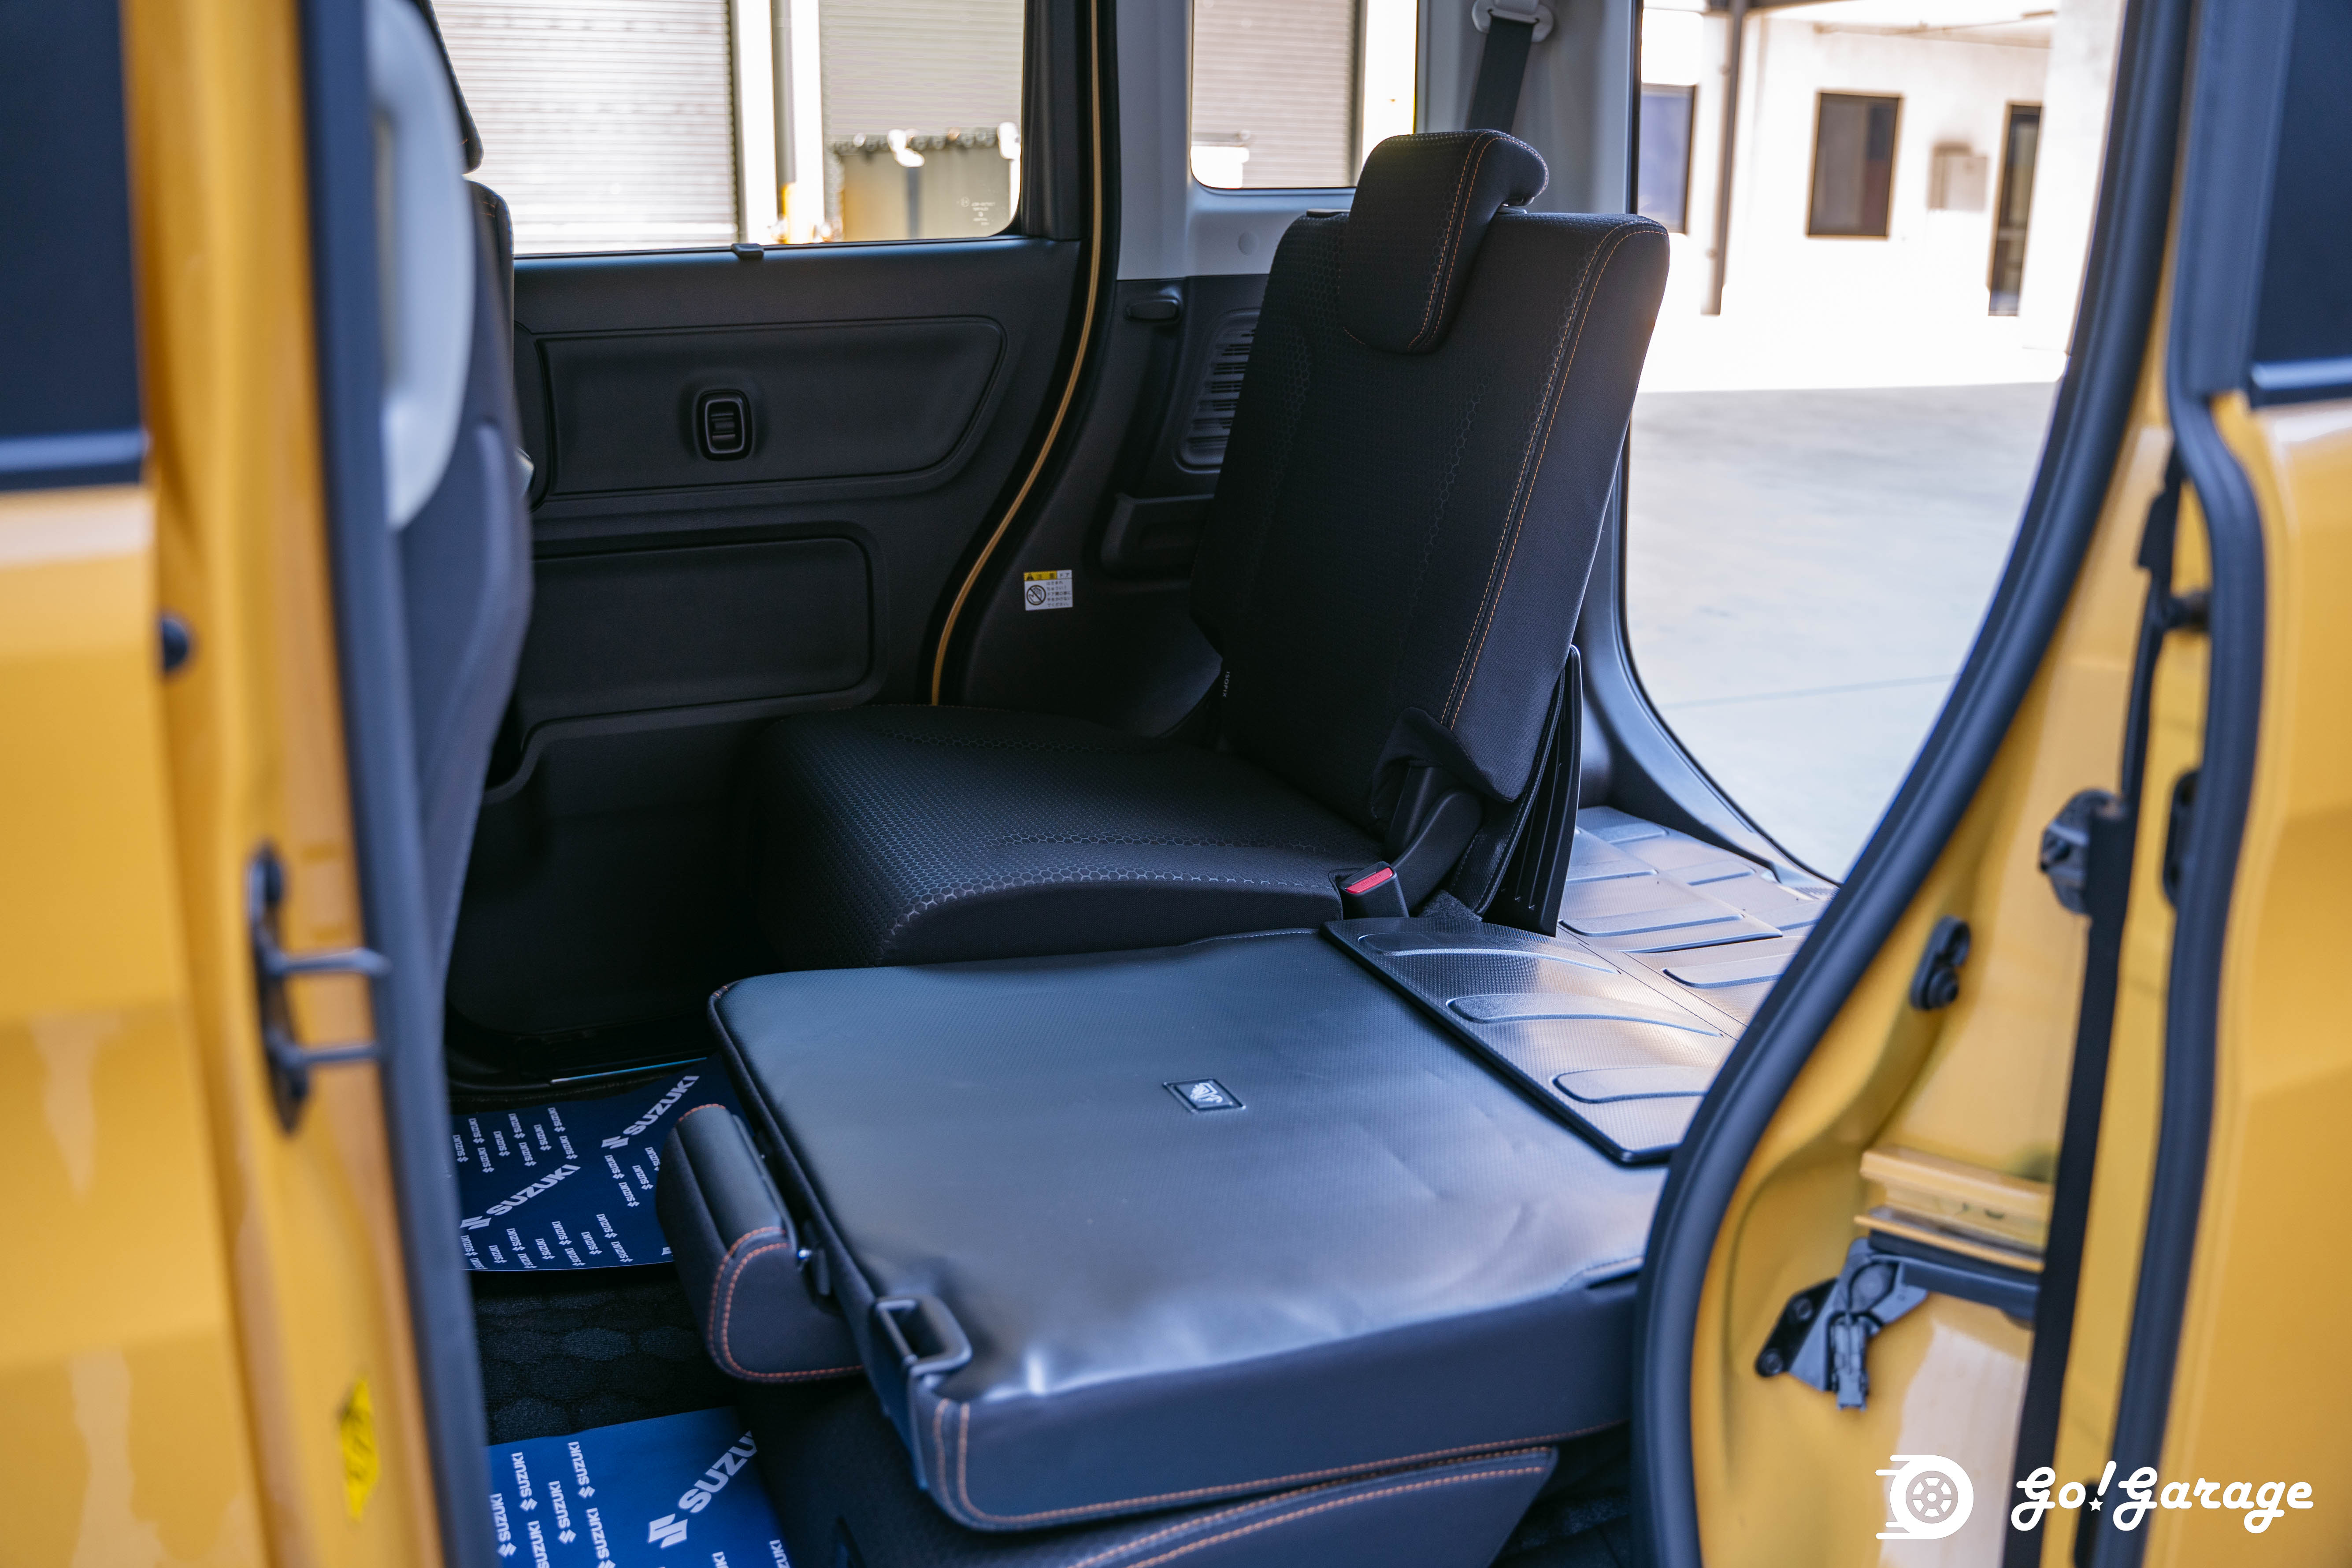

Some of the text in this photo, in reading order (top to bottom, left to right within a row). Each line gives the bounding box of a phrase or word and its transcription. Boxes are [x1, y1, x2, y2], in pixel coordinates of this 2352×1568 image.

[623, 1075, 699, 1135] SUZUKI
[508, 1113, 522, 1133] SUZUKI
[548, 1107, 562, 1127] SUZUKI
[468, 1118, 482, 1138] SUZUKI
[534, 1124, 548, 1145] SUZUKI
[453, 1134, 465, 1157] SUZUKI
[493, 1131, 507, 1151] SUZUKI
[559, 1135, 574, 1155] SUZUKI
[477, 1147, 491, 1168] SUZUKI
[519, 1142, 533, 1161] SUZUKI
[604, 1154, 621, 1174] SUZUKI
[632, 1165, 649, 1185] SUZUKI
[486, 1164, 581, 1216] SUZUKI
[618, 1182, 635, 1202] SUZUKI
[552, 1221, 568, 1240] SUZUKI
[596, 1213, 613, 1233] SUZUKI
[460, 1235, 475, 1252] SUZUKI
[506, 1228, 522, 1246] SUZUKI
[535, 1238, 551, 1256] SUZUKI
[581, 1231, 598, 1250] SUZUKI
[489, 1245, 504, 1260] SUZUKI
[564, 1248, 581, 1263] SUZUKI
[611, 1241, 628, 1259] SUZUKI
[568, 1441, 590, 1486] SUZUKI
[678, 1430, 758, 1513] SUZU
[512, 1452, 533, 1498] SUZUKI
[548, 1480, 571, 1529] SUZUKI
[489, 1493, 511, 1542] SUZUKI
[586, 1507, 610, 1560] SUZUKI
